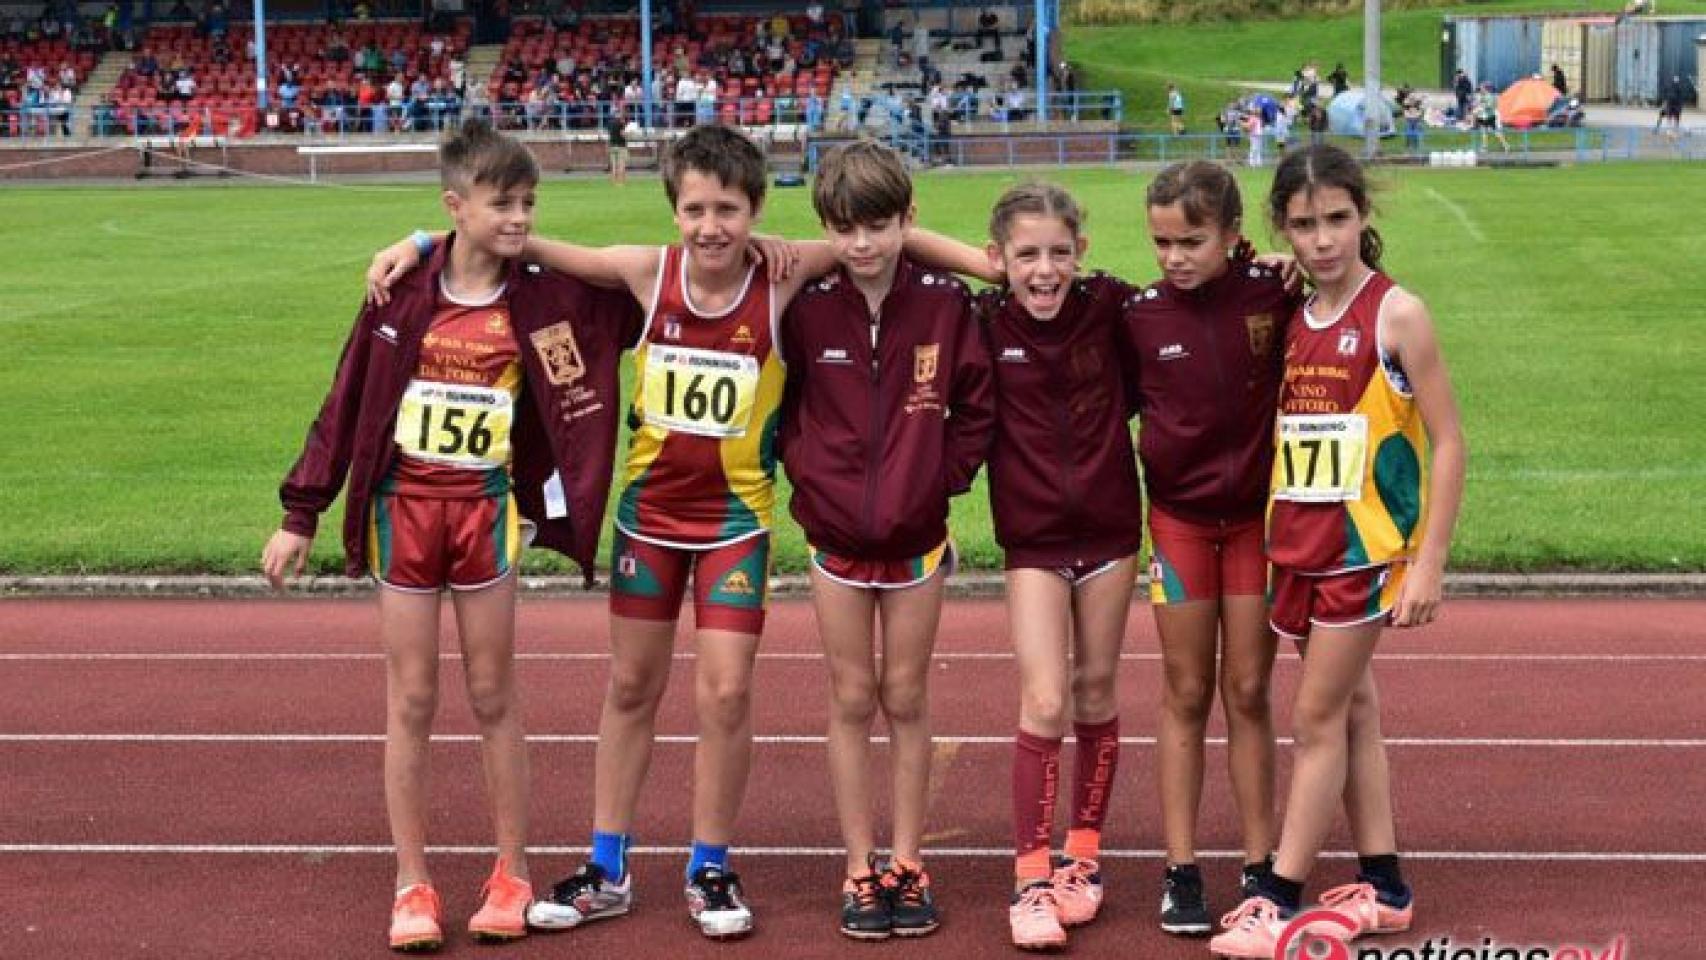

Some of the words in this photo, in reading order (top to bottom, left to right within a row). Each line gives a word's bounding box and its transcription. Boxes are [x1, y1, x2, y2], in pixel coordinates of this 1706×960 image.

[664, 369, 737, 425] 160
[418, 403, 492, 457] 156
[1283, 440, 1341, 488] 171
